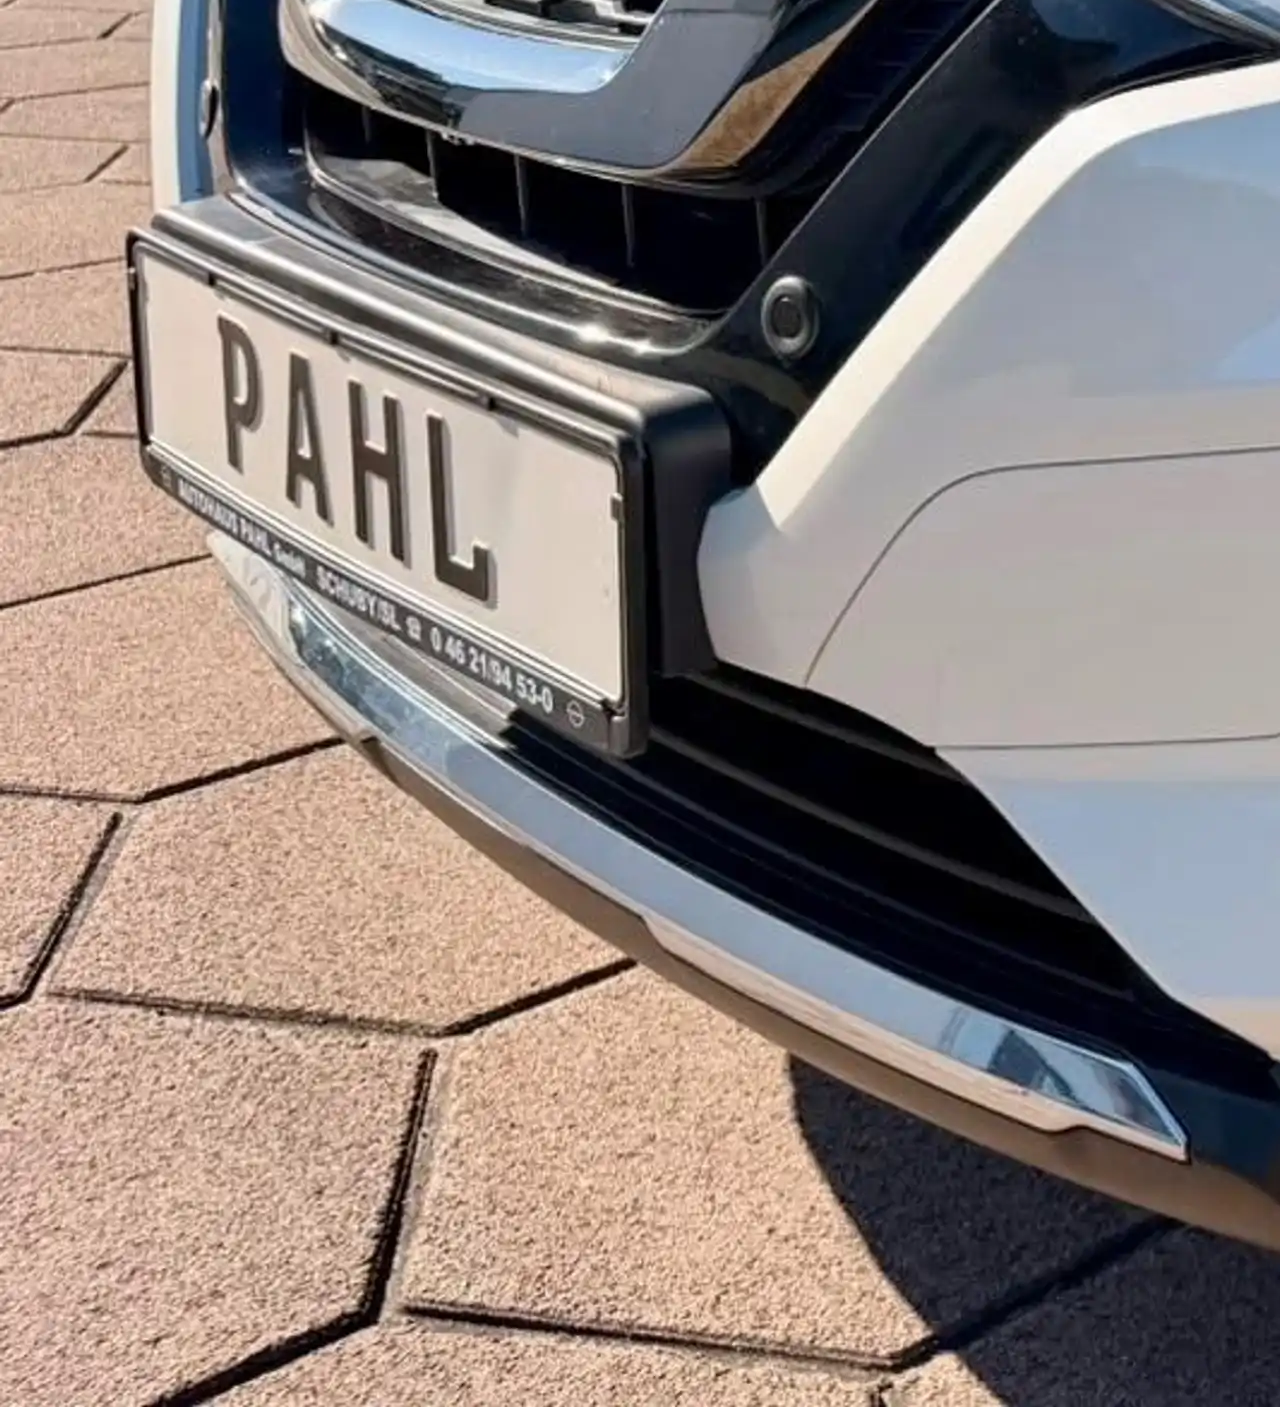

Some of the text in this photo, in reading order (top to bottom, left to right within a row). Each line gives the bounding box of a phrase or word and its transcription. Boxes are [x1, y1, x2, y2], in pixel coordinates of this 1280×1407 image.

[217, 311, 493, 605] PAHL
[429, 625, 442, 653] 0
[444, 634, 466, 665] 46
[516, 672, 553, 714] 53-0
